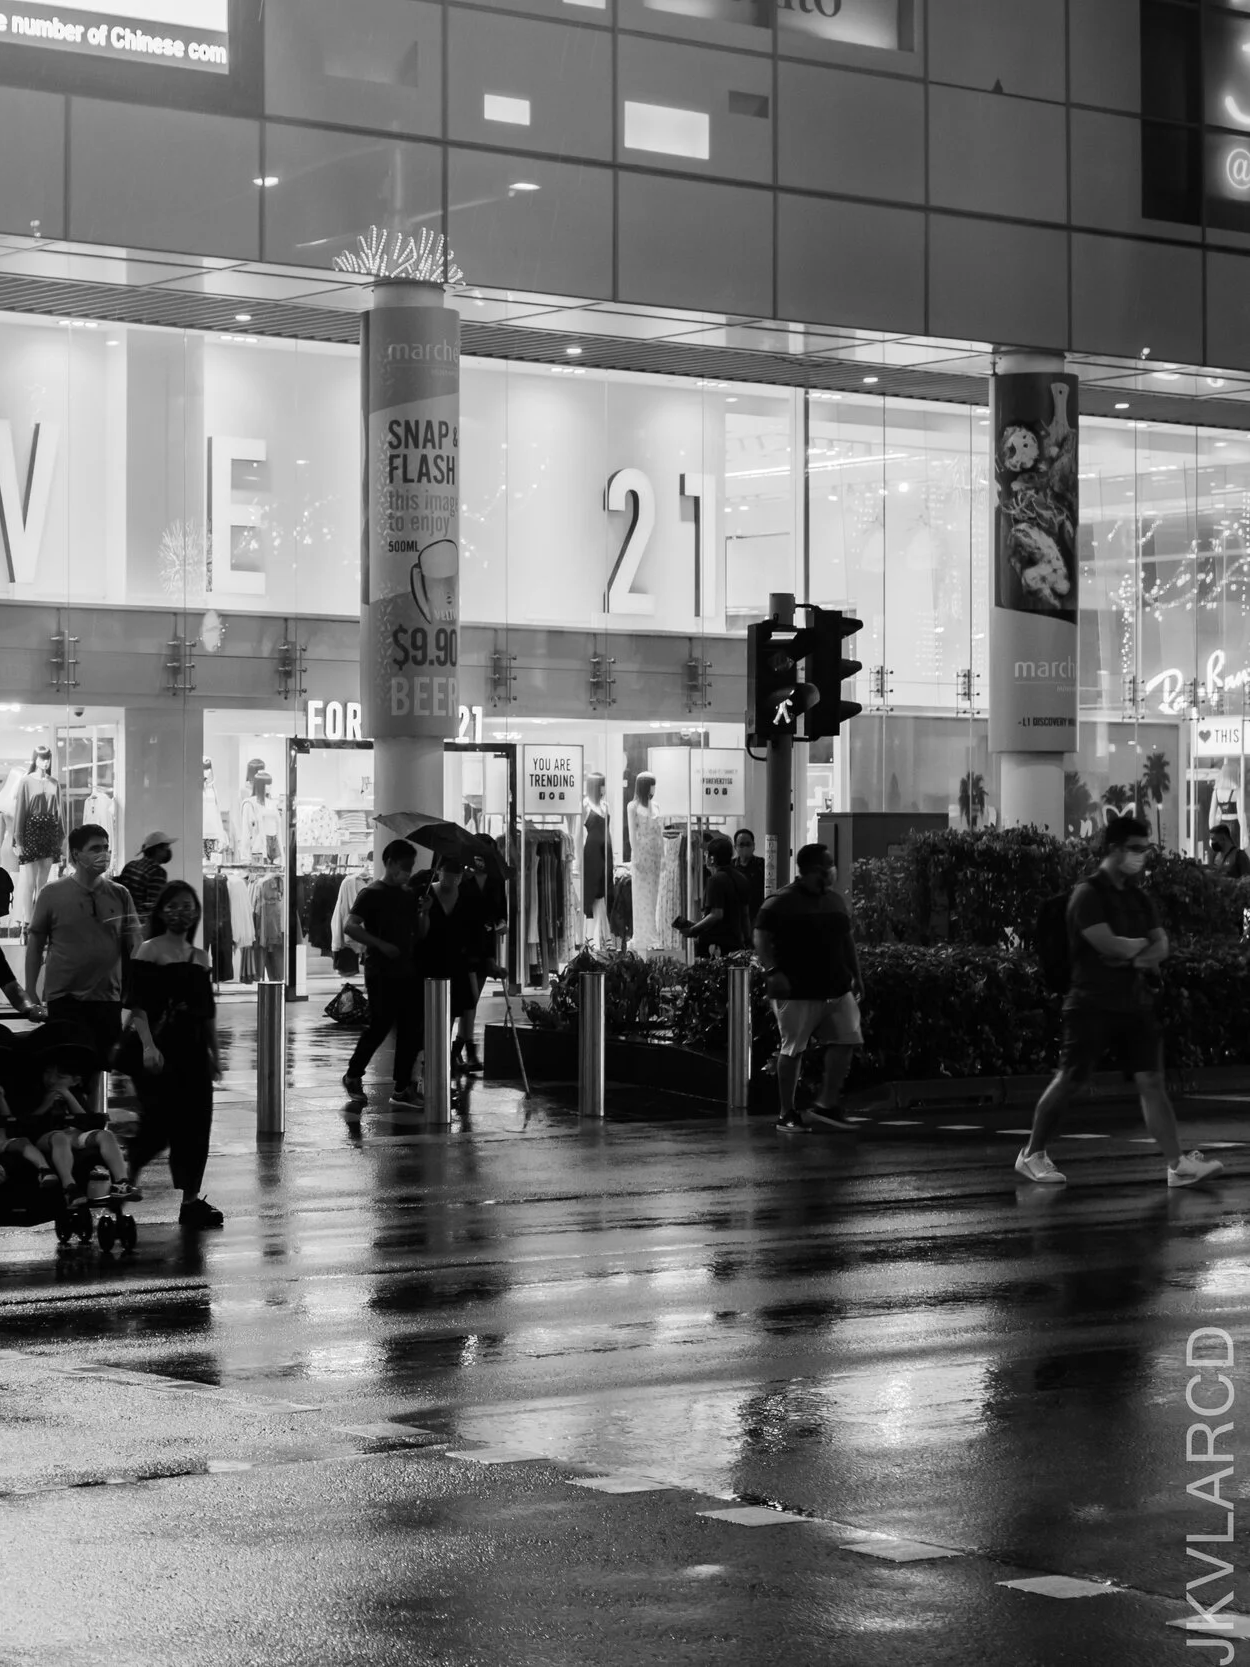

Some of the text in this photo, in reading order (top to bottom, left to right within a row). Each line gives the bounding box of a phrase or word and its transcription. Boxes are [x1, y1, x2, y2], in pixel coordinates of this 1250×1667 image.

[11, 15, 85, 43] number
[87, 24, 109, 46] of
[110, 26, 185, 58] Chinese
[187, 42, 227, 64] com
[388, 420, 449, 450] SNAP
[388, 453, 455, 486] FLASH
[388, 489, 419, 511] this
[388, 511, 450, 537] to enjoy
[388, 540, 420, 552] 500ML
[392, 624, 458, 672] $9.90
[1215, 729, 1240, 743] THIS
[533, 757, 571, 771] YOU ARE
[529, 774, 575, 788] TRENDING
